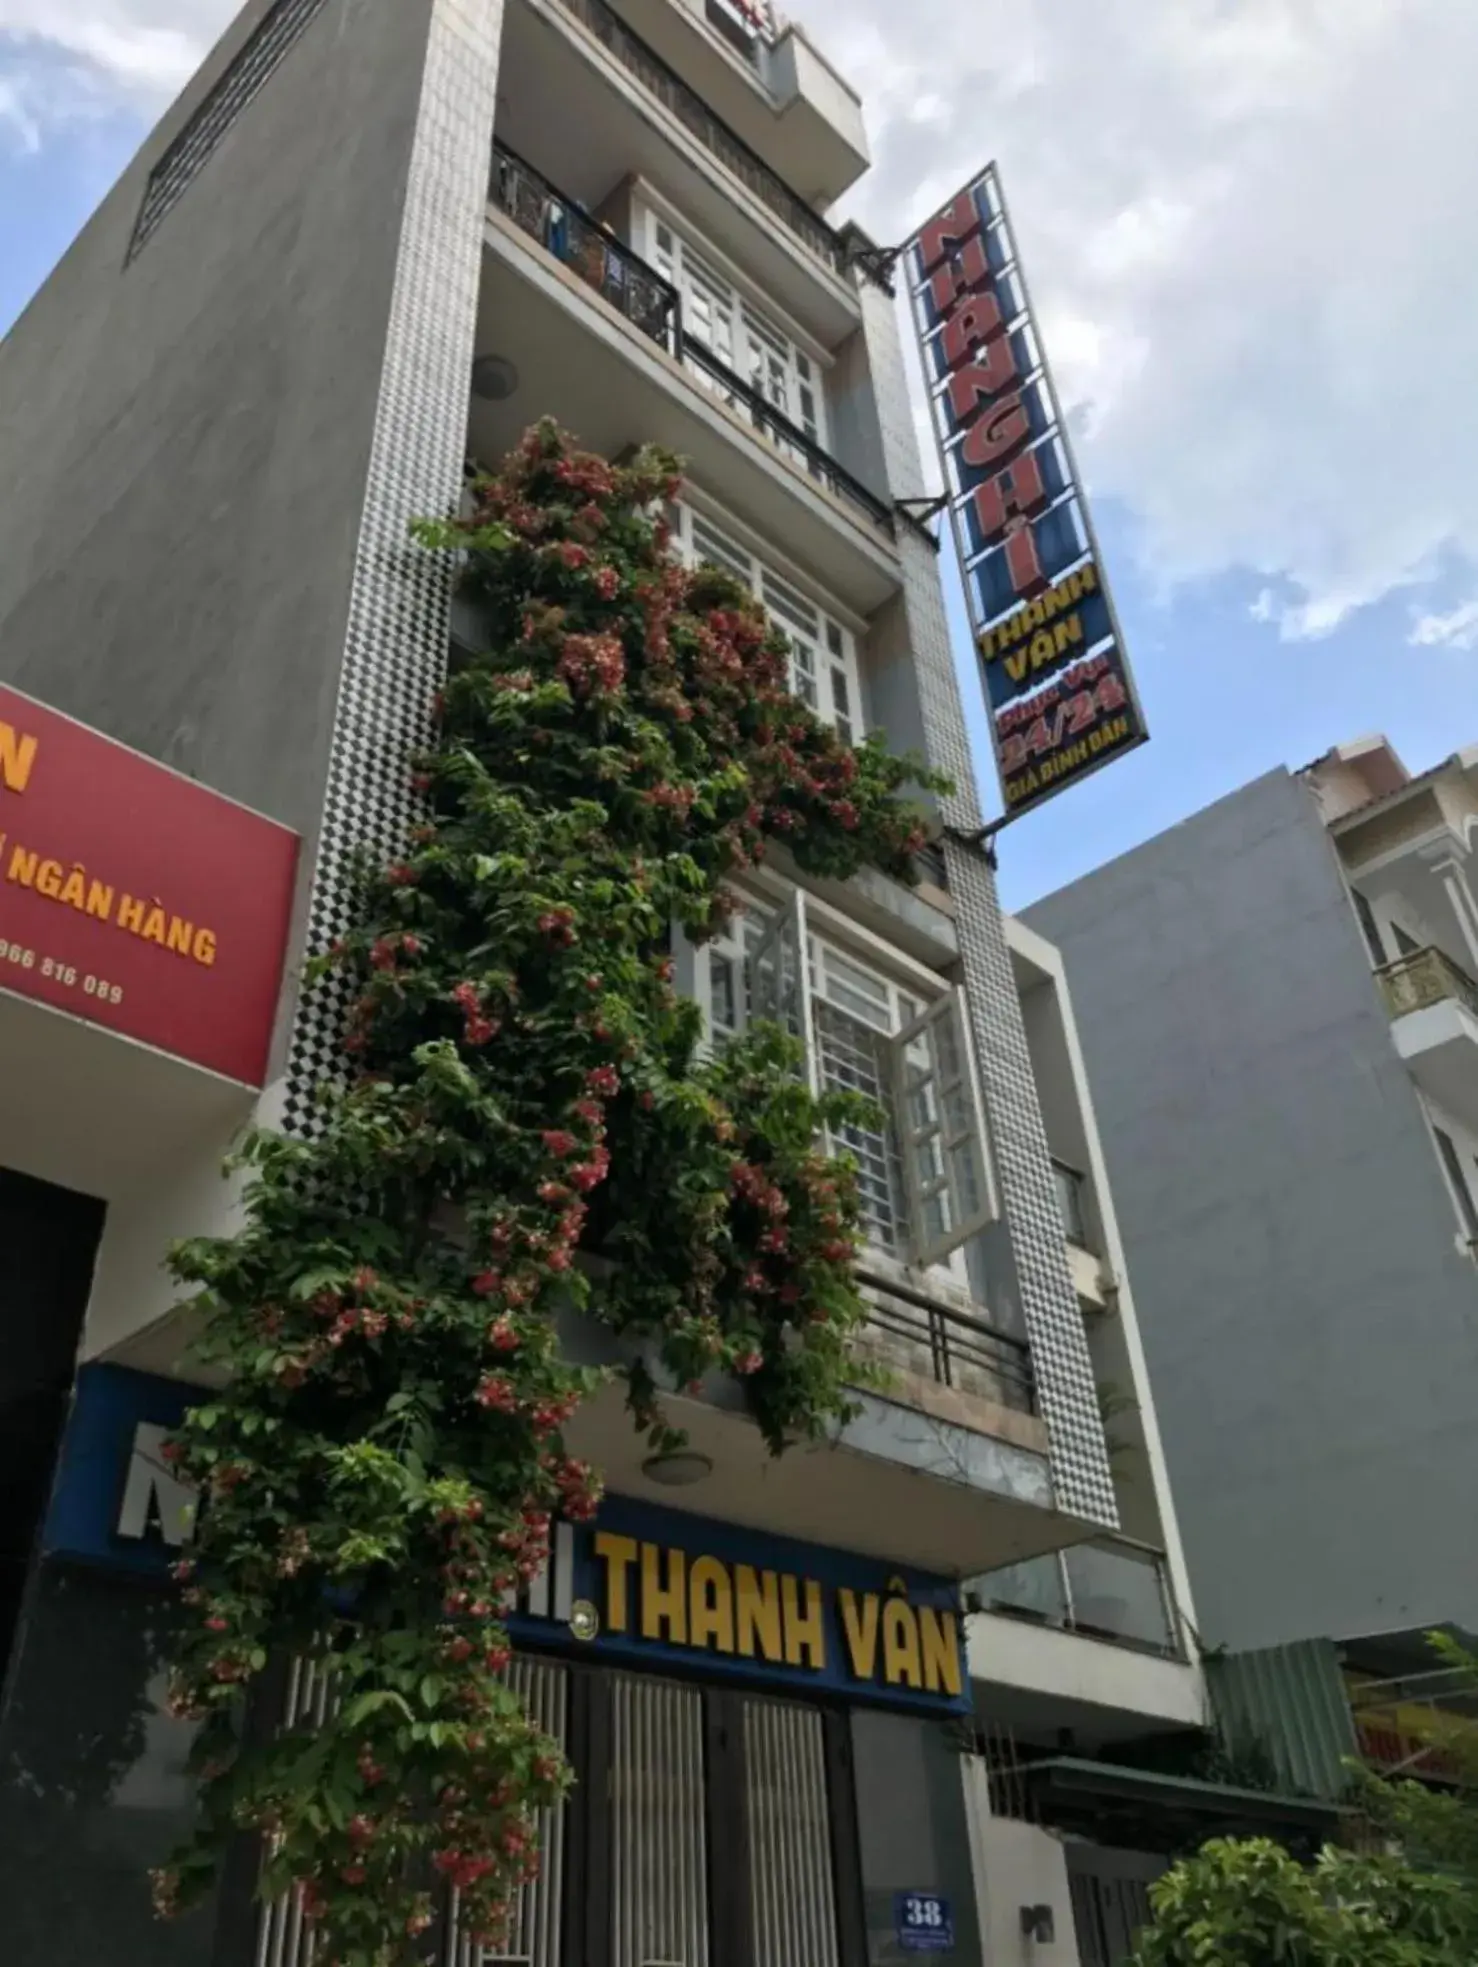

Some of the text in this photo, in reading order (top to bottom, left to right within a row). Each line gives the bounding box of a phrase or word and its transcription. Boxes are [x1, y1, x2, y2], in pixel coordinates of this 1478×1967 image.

[980, 564, 1097, 658] THANH
[1004, 614, 1083, 682] VÂN
[1002, 673, 1126, 775] 24/24
[8, 845, 114, 920] NGÂN
[117, 893, 216, 966] HÀNG
[40, 956, 77, 987] 816
[83, 974, 123, 1004] 089
[595, 1531, 826, 1669] THANH
[839, 1577, 963, 1696] VÂN
[906, 1898, 942, 1926] 38
